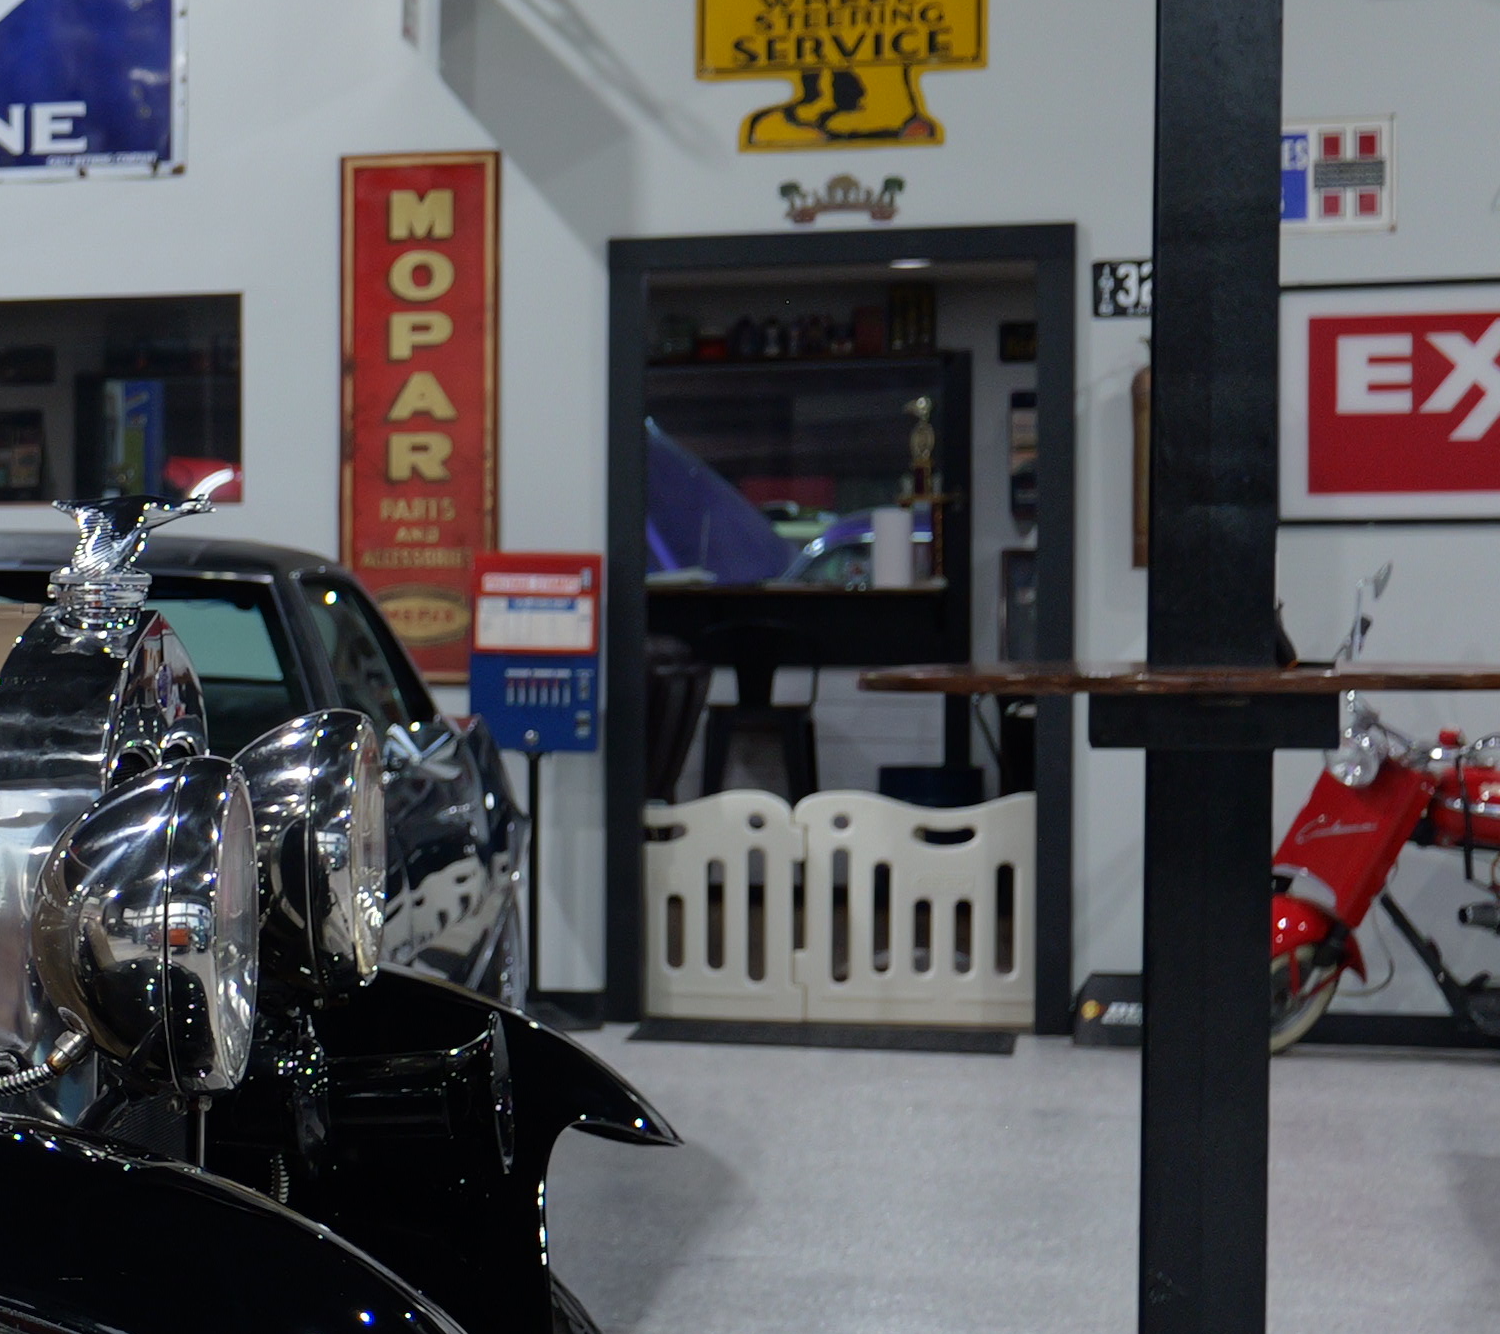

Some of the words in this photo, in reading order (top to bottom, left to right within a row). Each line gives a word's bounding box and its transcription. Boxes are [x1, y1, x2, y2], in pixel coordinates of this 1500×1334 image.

[733, 27, 953, 64] SERVICE
[385, 187, 458, 482] MOPAR
[379, 497, 456, 522] PARTS
